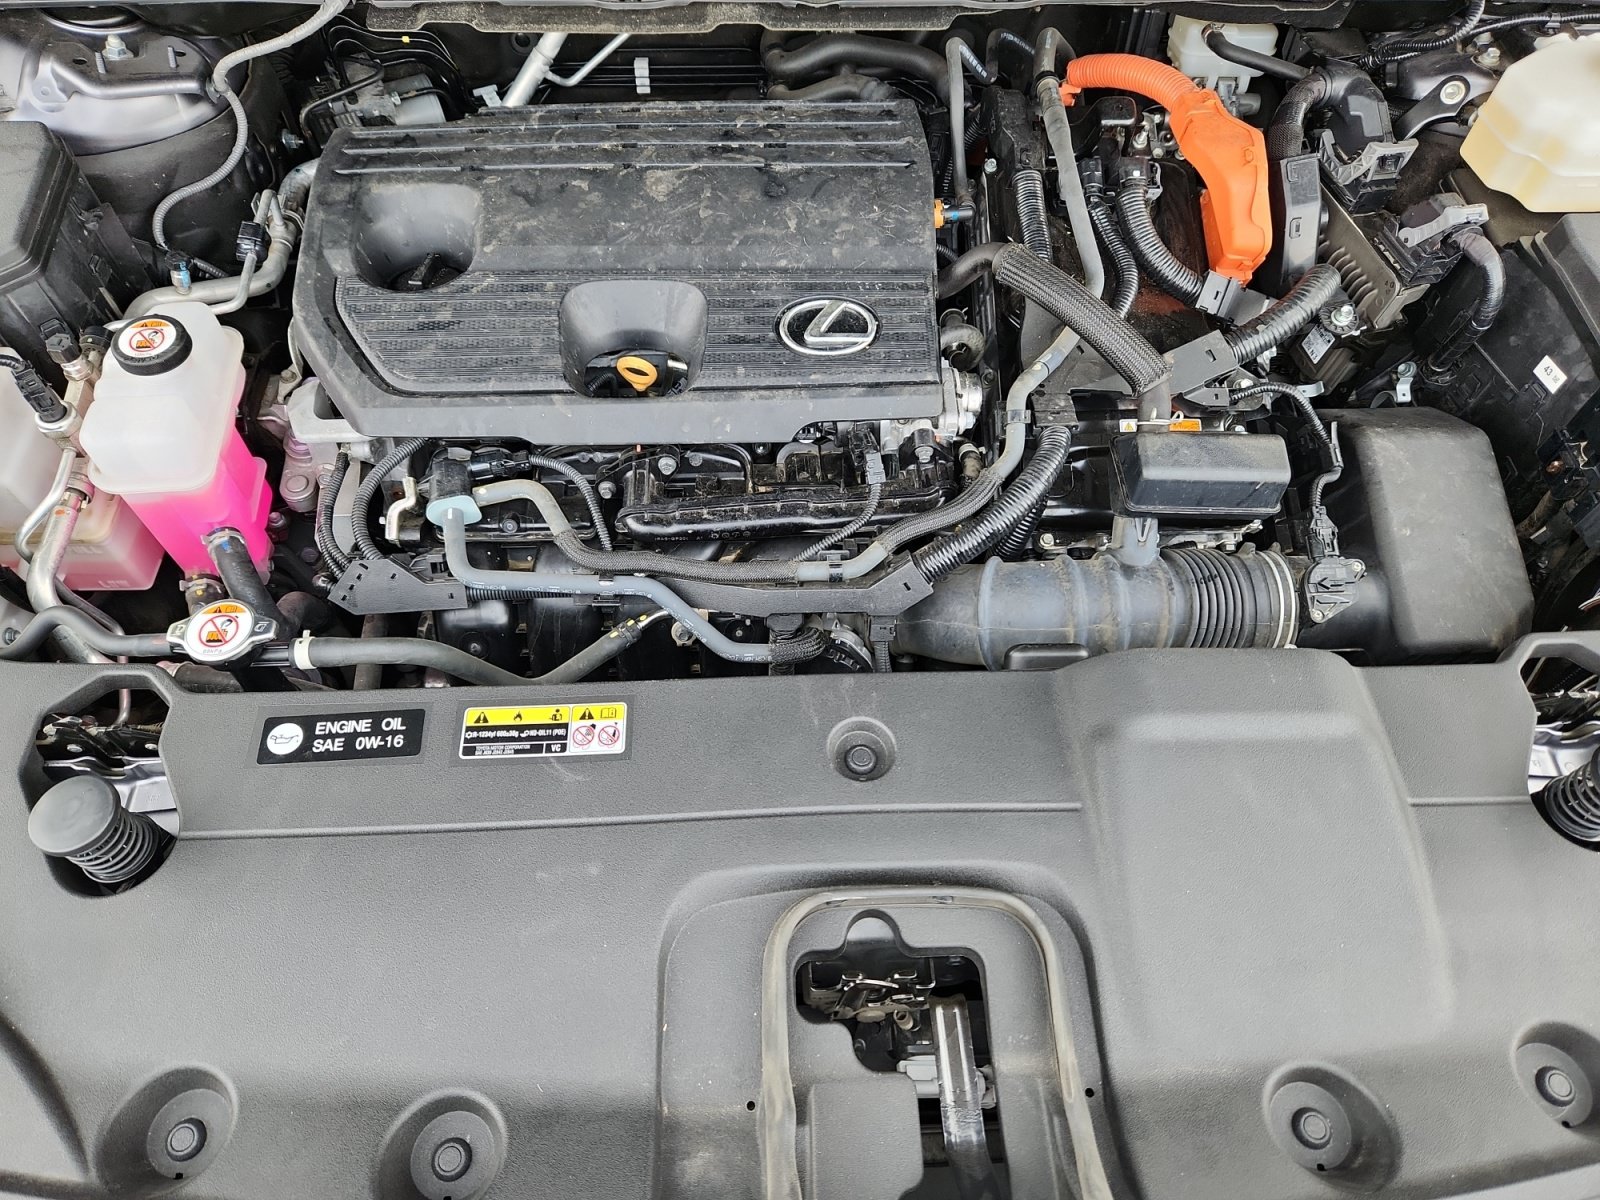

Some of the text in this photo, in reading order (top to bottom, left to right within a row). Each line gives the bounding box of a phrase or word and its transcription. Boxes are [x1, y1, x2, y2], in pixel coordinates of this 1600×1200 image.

[315, 718, 406, 735] ENGINE OIL
[312, 734, 404, 753] SAE 0W-16
[551, 744, 561, 752] VC
